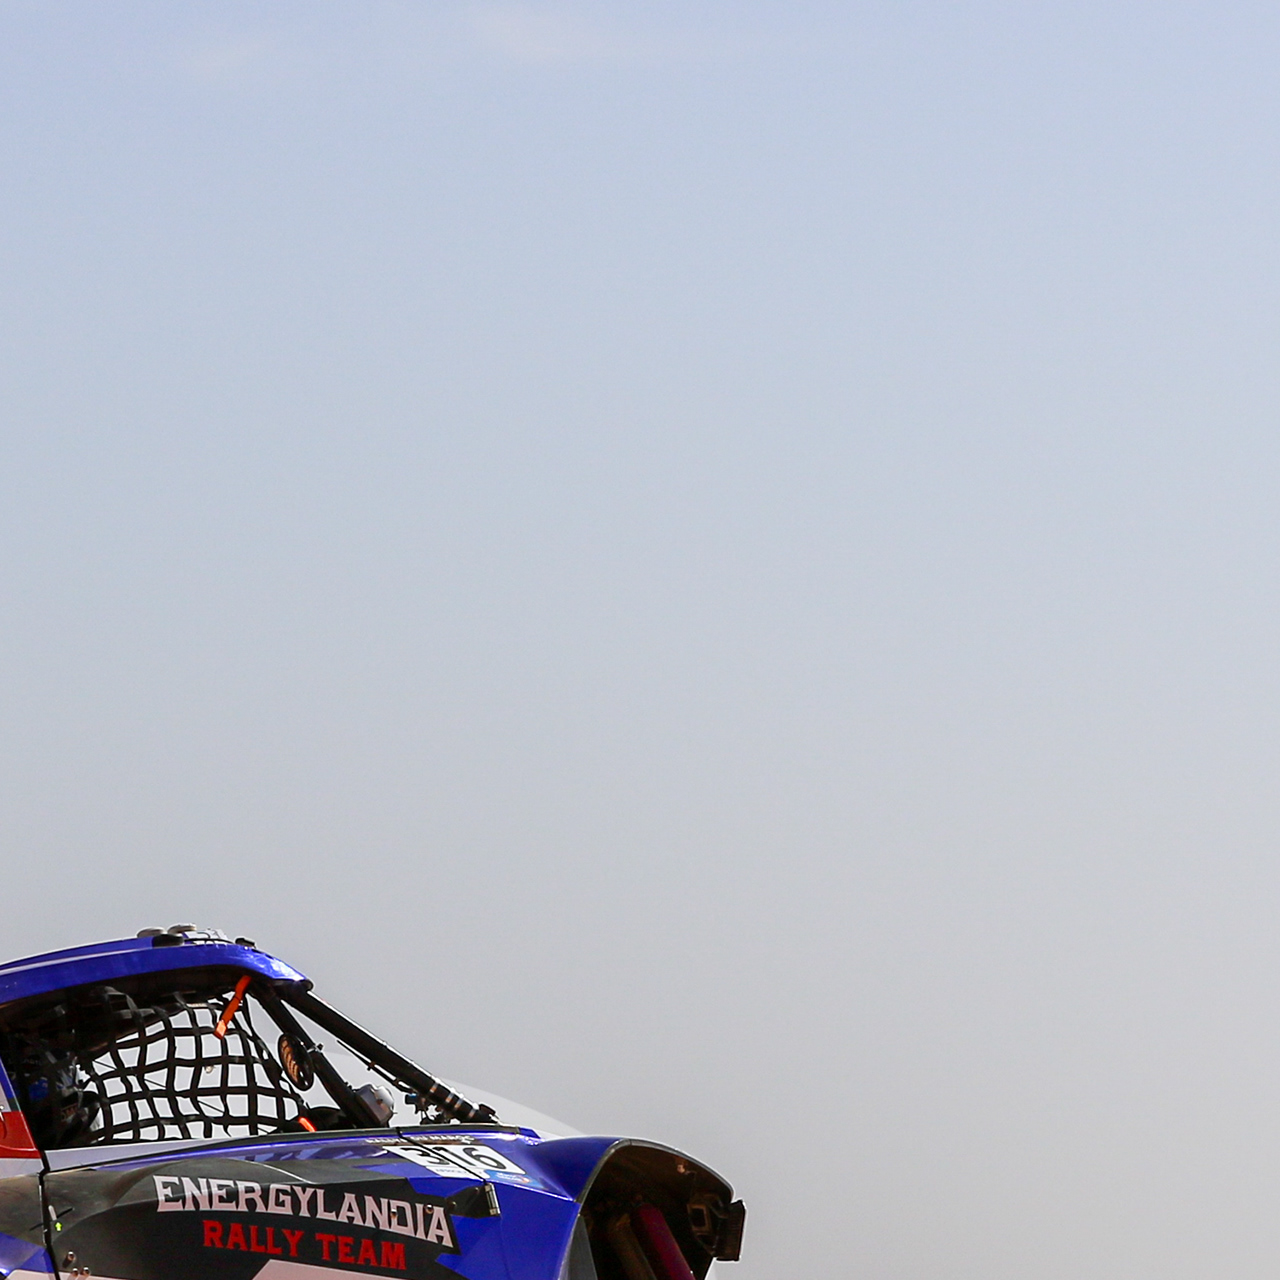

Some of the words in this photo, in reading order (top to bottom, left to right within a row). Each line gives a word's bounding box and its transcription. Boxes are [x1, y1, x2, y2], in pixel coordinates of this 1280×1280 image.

[400, 1146, 507, 1170] 316
[152, 1175, 455, 1248] ENERGYLANDIA
[202, 1220, 305, 1257] RALLY
[316, 1233, 408, 1271] TEAM
